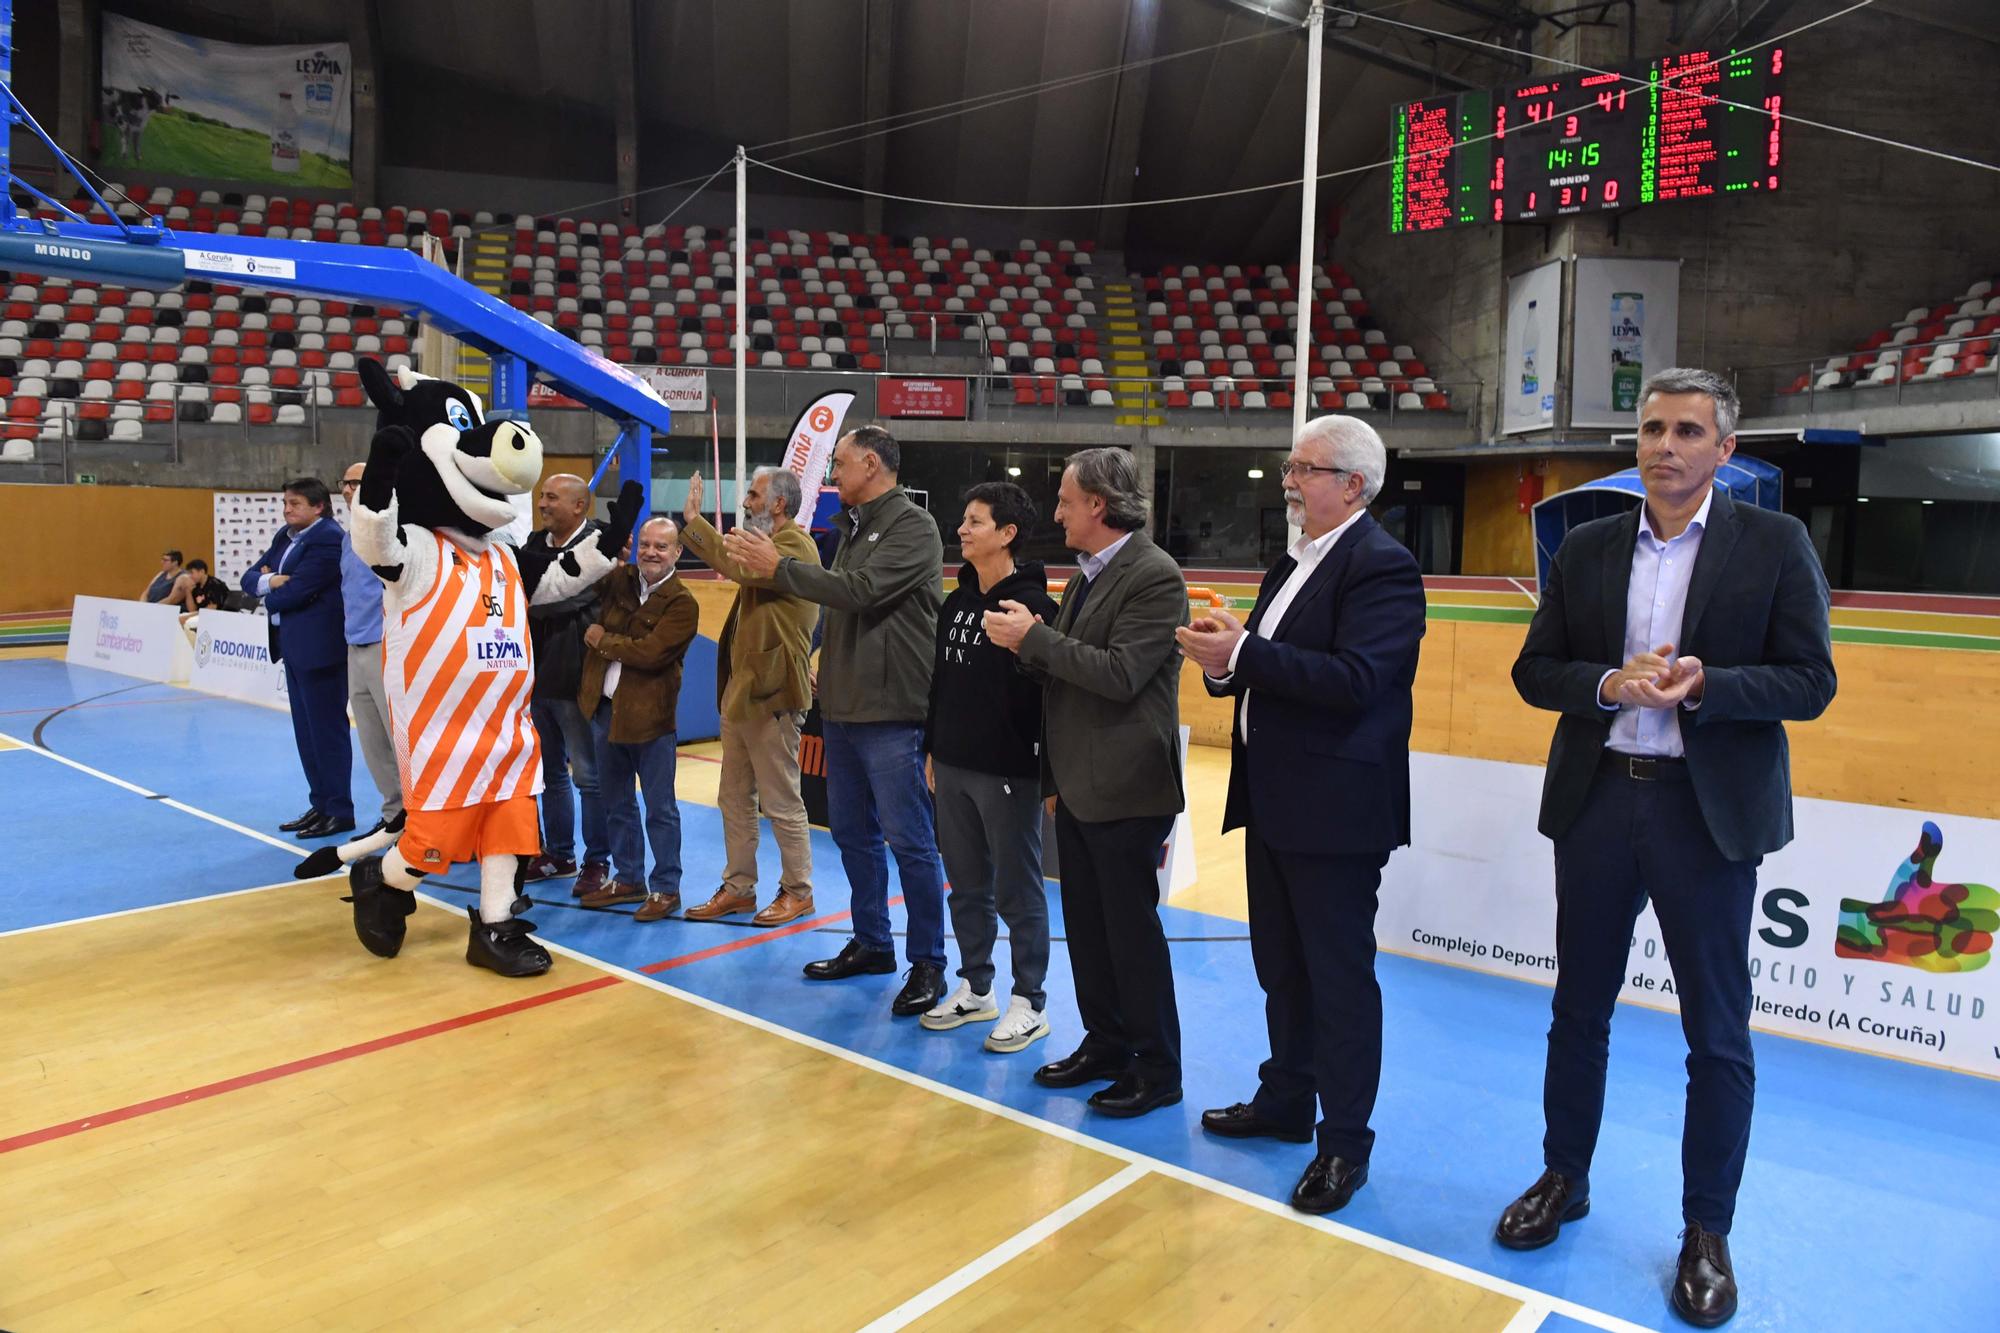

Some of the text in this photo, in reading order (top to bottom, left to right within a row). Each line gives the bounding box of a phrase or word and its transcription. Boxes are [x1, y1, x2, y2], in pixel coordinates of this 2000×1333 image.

[296, 58, 342, 75] LEYMA
[1650, 70, 1658, 81] 0
[1599, 89, 1625, 112] 41
[1650, 93, 1657, 104] 3
[1765, 96, 1780, 109] 10
[1528, 101, 1553, 122] 41
[1566, 116, 1578, 136] 3
[1643, 126, 1656, 136] 10
[1642, 137, 1655, 148] 15
[1548, 144, 1600, 170] 14:15
[1642, 148, 1655, 158] 23
[1550, 174, 1590, 186] MONDO
[1561, 187, 1587, 205] 31
[1604, 180, 1618, 200] 0
[1529, 192, 1536, 210] 1
[34, 244, 92, 261] MONDO
[663, 388, 702, 400] CORUÑA
[482, 594, 503, 616] 96
[214, 640, 268, 662] RODONITA
[478, 642, 523, 660] LEYMA
[486, 660, 518, 669] NATURA
[1412, 928, 1487, 957] Complejo
[1632, 972, 1654, 990] de
[1844, 974, 1854, 995] Y
[1880, 981, 1984, 1020] SALUD
[1828, 1010, 1850, 1030] (A
[1858, 1016, 1946, 1050] Coruña)
